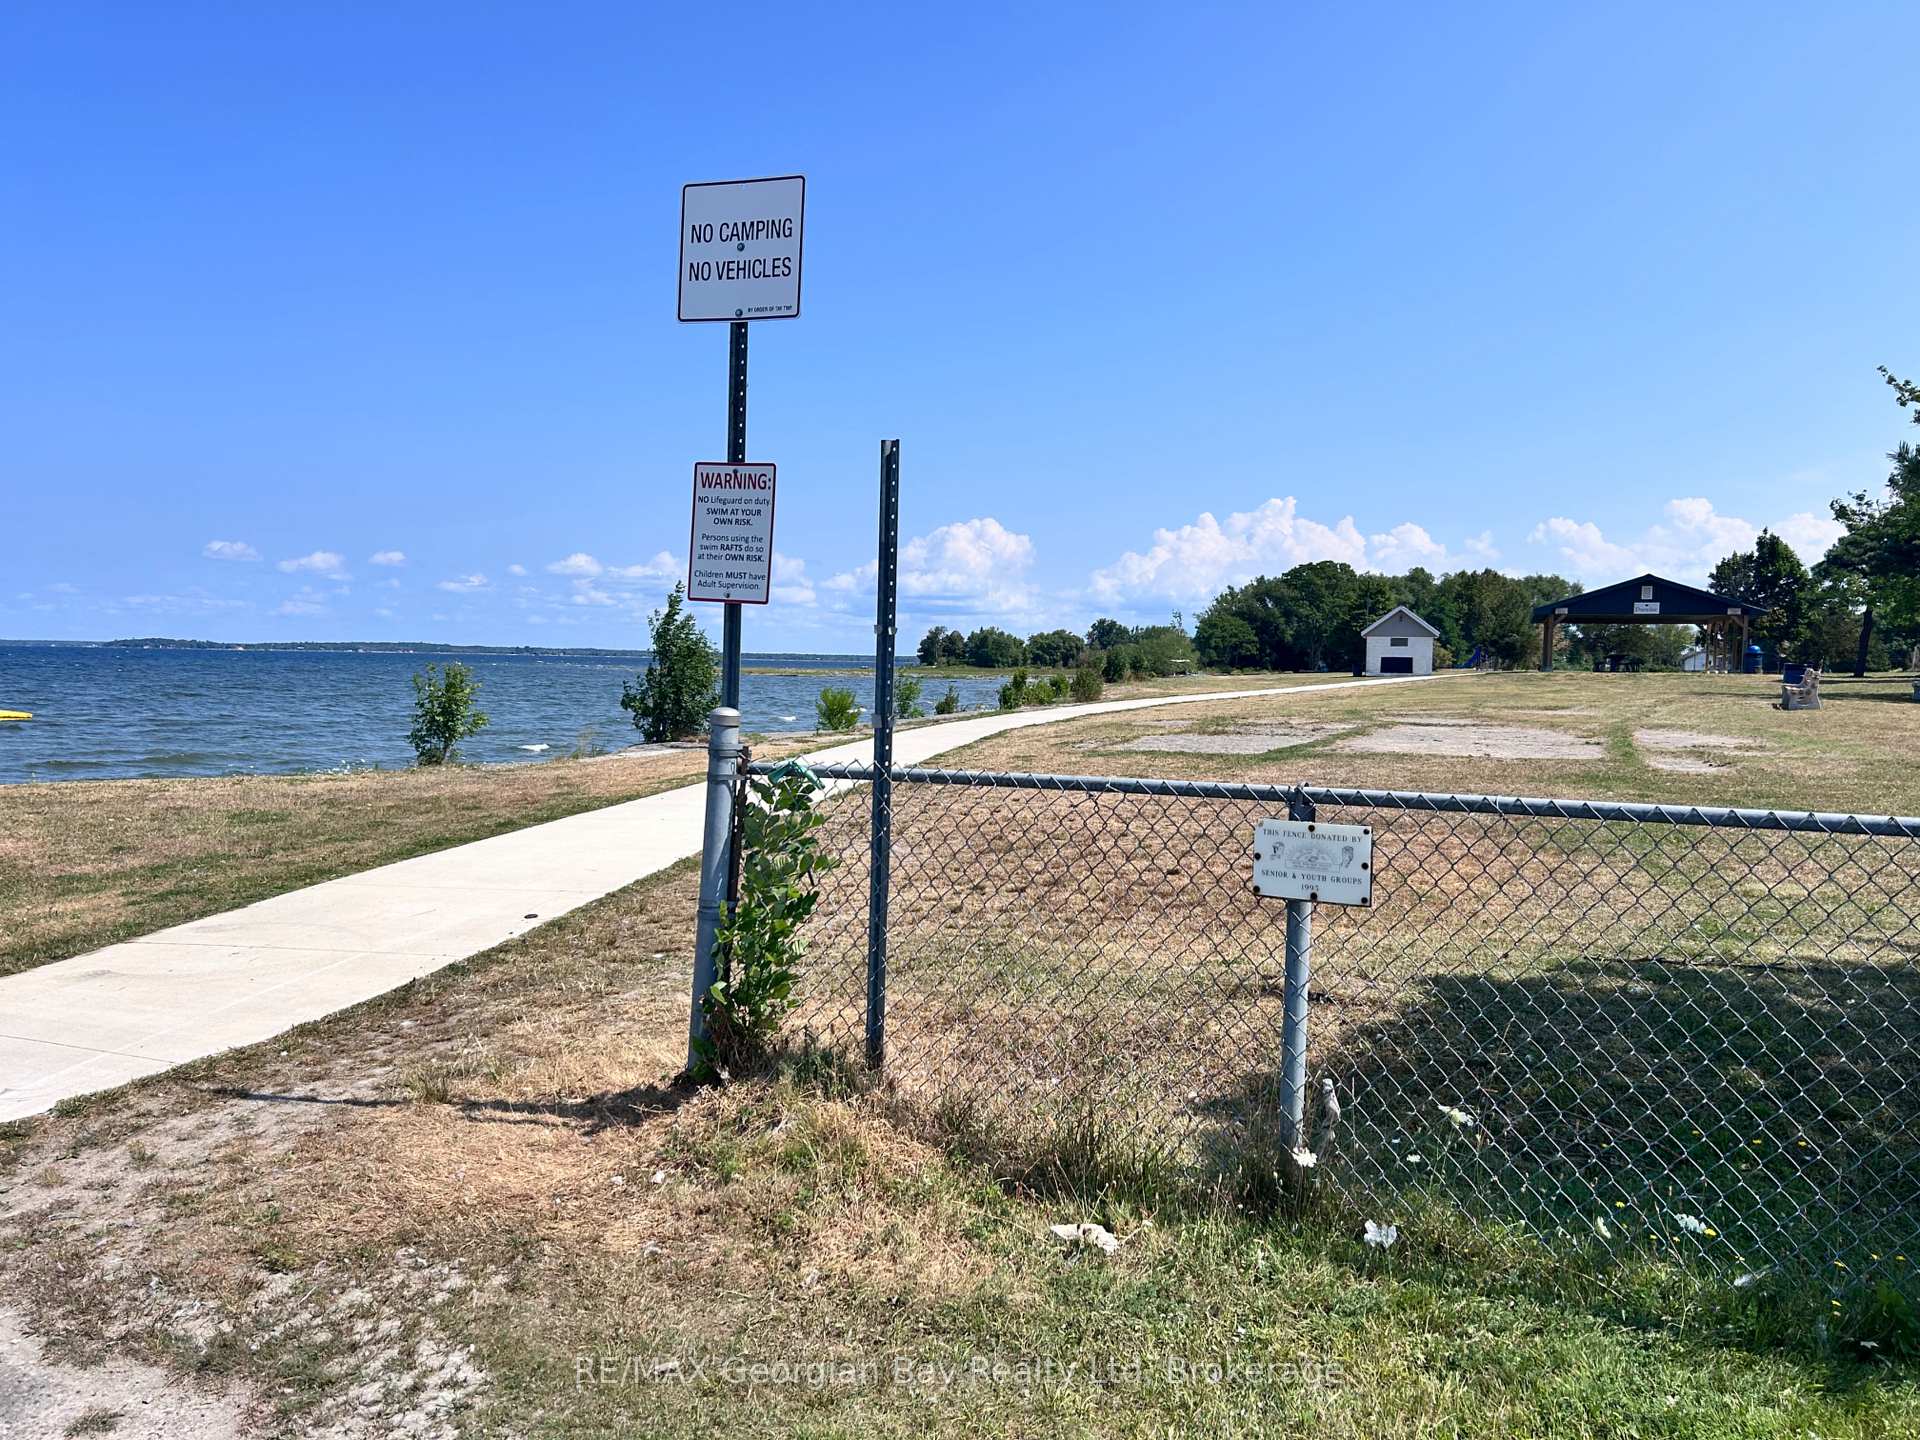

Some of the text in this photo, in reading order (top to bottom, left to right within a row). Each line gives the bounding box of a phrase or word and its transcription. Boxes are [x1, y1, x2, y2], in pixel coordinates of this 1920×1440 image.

[691, 217, 793, 244] NO CAMPING
[688, 256, 792, 282] NO VEHICLES
[700, 471, 771, 490] WARNING:
[697, 495, 710, 504] NO
[711, 495, 742, 506] Lifeguard
[754, 496, 770, 507] duty
[706, 507, 762, 516] SWIM AT YOUR
[713, 517, 753, 526] OWN RISK.
[701, 533, 764, 543] Persons using the
[720, 543, 743, 552] RAFTS
[725, 553, 744, 561] OWN
[746, 554, 765, 562] RISK.
[694, 569, 766, 580] Children MUST have
[697, 579, 760, 590] Adult Supervision.
[1263, 828, 1279, 836] THIS
[1283, 830, 1306, 838] FENCE
[1310, 831, 1348, 842] DONATED
[1261, 869, 1288, 878] SENIOR
[1301, 873, 1327, 882] YOUTH
[1330, 876, 1362, 885] GROUPS
